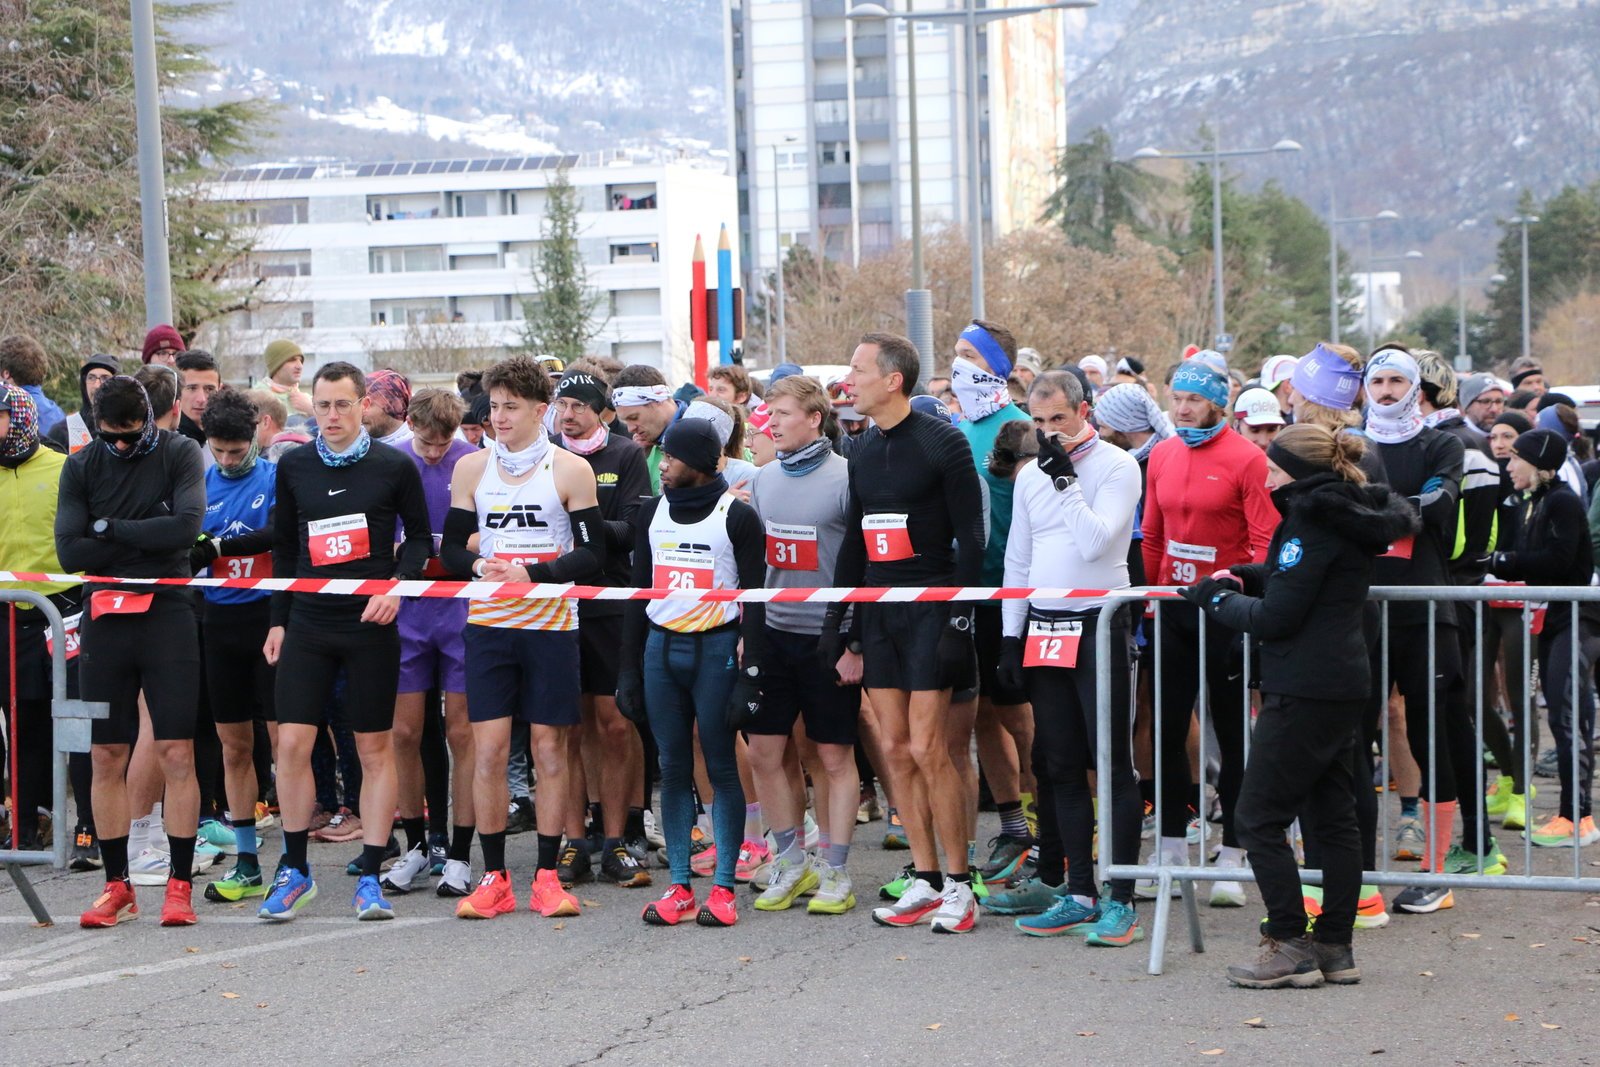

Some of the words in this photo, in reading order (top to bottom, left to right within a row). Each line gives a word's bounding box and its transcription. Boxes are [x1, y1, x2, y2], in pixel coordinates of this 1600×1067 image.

[578, 521, 590, 543] KIPRUN
[325, 534, 353, 558] 35
[775, 541, 798, 564] 31
[877, 533, 889, 556] 5
[228, 557, 255, 579] 37
[1171, 560, 1197, 583] 39
[668, 570, 695, 590] 26
[1039, 638, 1063, 660] 12
